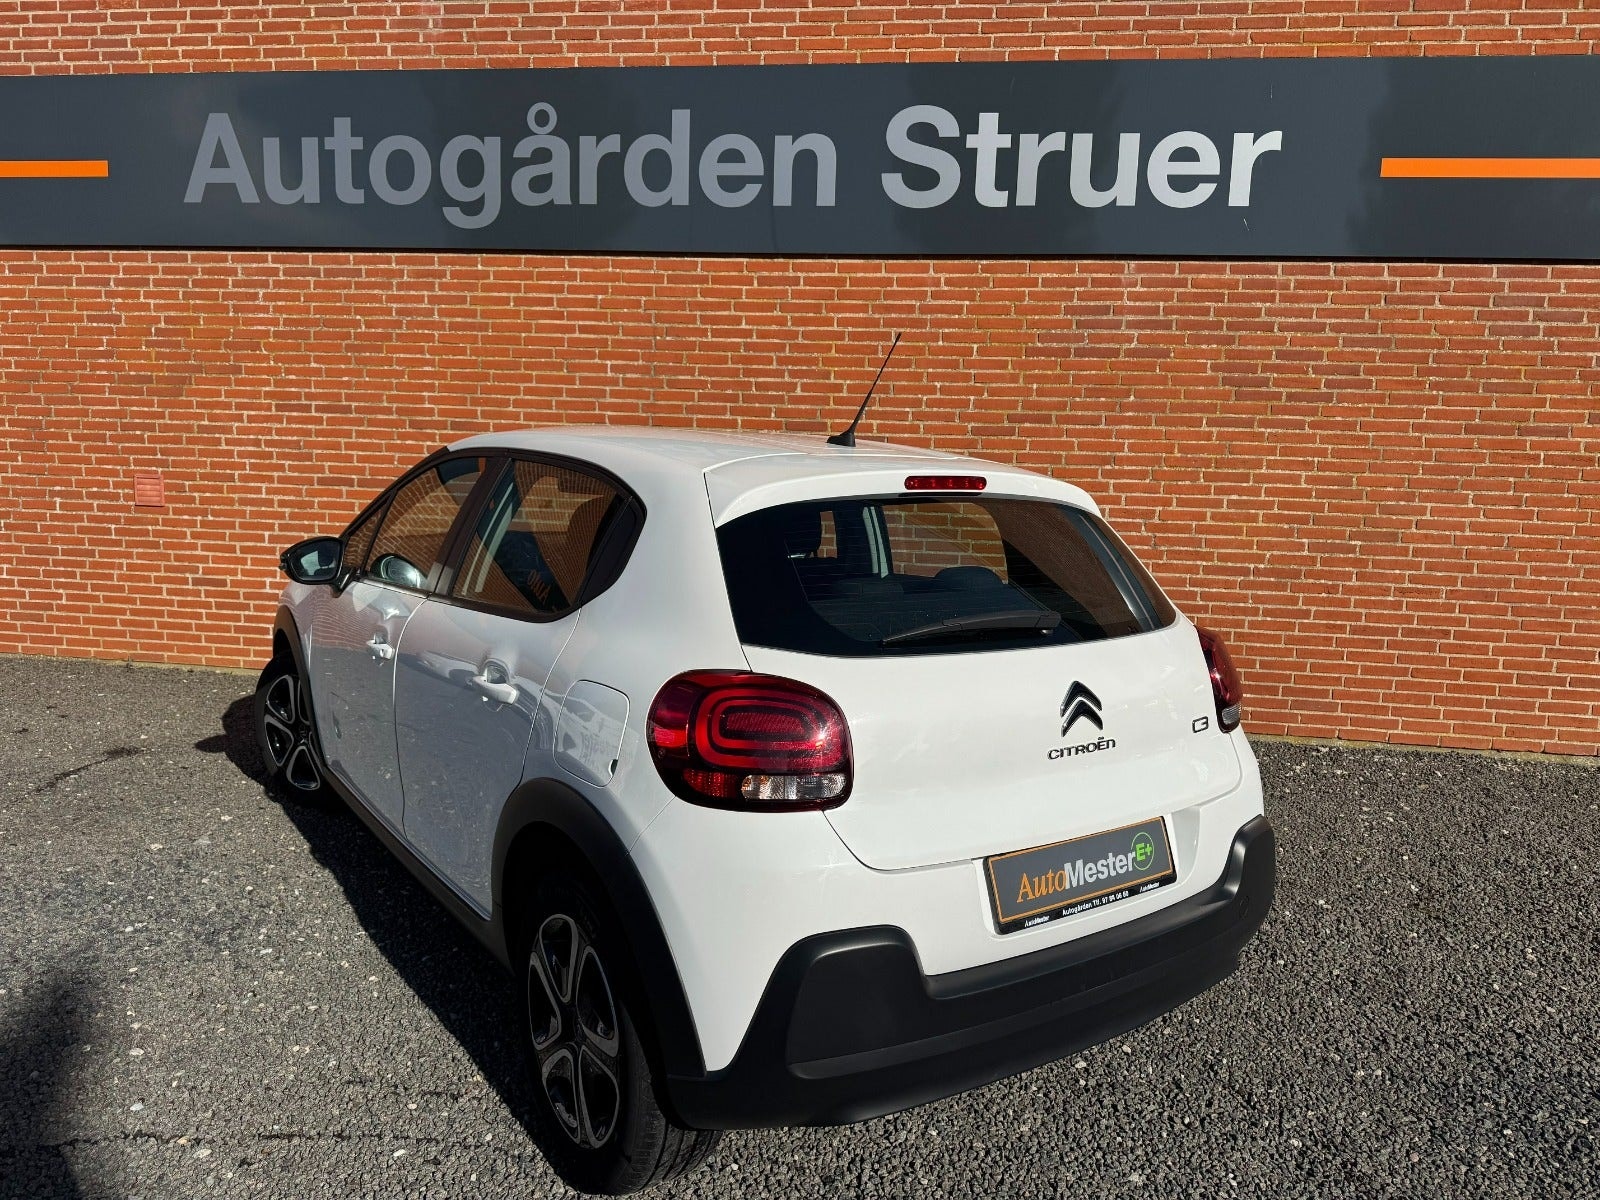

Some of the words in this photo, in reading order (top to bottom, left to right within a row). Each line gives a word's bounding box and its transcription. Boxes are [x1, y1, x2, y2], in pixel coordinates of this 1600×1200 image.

[183, 102, 837, 229] Autogården
[881, 104, 1282, 209] Struer
[1016, 851, 1136, 903] AutoMester
